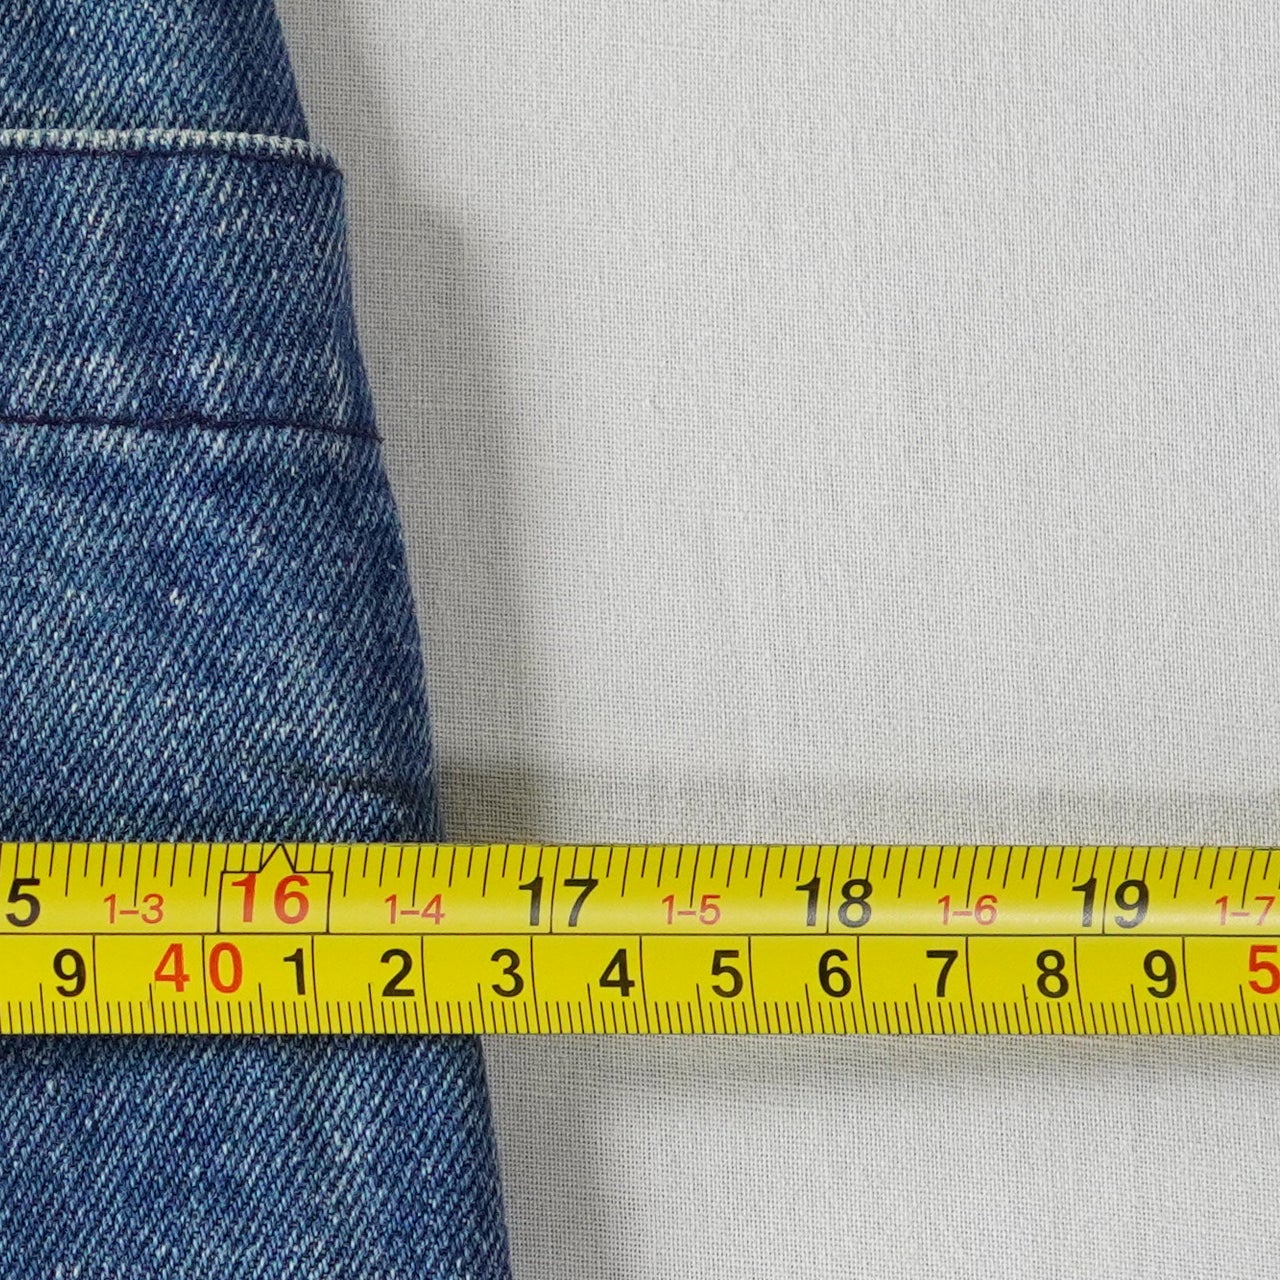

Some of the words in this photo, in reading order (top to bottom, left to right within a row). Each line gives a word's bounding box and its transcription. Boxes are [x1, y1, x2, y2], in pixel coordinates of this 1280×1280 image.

[104, 893, 164, 924] 1-3
[232, 873, 310, 925] 16
[384, 894, 445, 925] 1-4
[519, 878, 598, 927] 17
[662, 894, 721, 925] 1-5
[795, 878, 873, 928] 18
[938, 894, 998, 925] 1-6
[1073, 878, 1150, 929] 19
[1215, 895, 1275, 925] 1-7
[54, 949, 86, 997] 9
[154, 942, 243, 995] 40
[284, 949, 306, 994] 1
[381, 949, 414, 996] 2
[491, 949, 523, 998] 3
[600, 949, 634, 996] 4
[712, 950, 742, 998] 5
[819, 949, 851, 998] 6
[927, 950, 958, 997] 7
[1037, 950, 1068, 999] 8
[1144, 950, 1176, 998] 9
